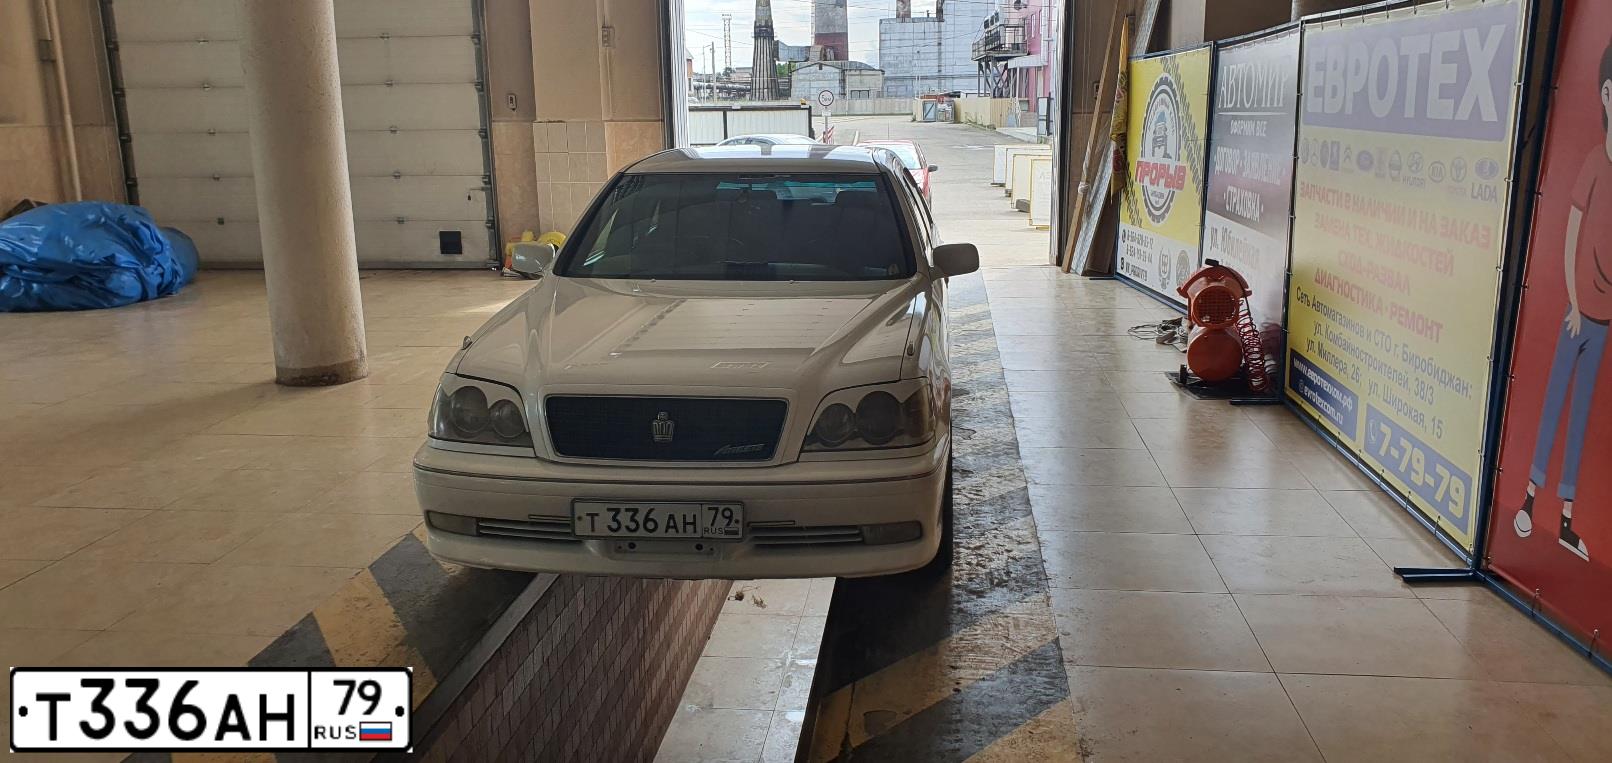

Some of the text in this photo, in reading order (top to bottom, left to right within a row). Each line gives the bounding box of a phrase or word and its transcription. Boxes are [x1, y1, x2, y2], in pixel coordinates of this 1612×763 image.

[1307, 24, 1506, 122] ЕВРОТЕХ
[1135, 160, 1187, 191] ПРОРЫВ
[1471, 182, 1498, 203] LADA
[1225, 185, 1260, 222] СТРАХОВКА
[1300, 180, 1343, 208] ЗАПЧАСТИ
[1440, 215, 1492, 250] ЗАКАЗ
[1375, 230, 1455, 277] ЖИДКОСТЕЙ
[1314, 267, 1444, 344] ДИАГНОСТИКА РЕМОНТ
[1296, 286, 1311, 307] Сеть
[1311, 295, 1365, 337] Автомагазинов
[1374, 329, 1392, 353] СТО
[1401, 343, 1473, 401] Биробиджан:
[1306, 337, 1316, 353] ул.
[1313, 320, 1322, 336] ул.
[1414, 377, 1434, 406] 38/3
[1382, 384, 1427, 433] Широкая,
[1431, 415, 1443, 440] 15
[1377, 420, 1467, 520] 7-79-79
[703, 527, 723, 535] RUS
[707, 506, 734, 527] 79
